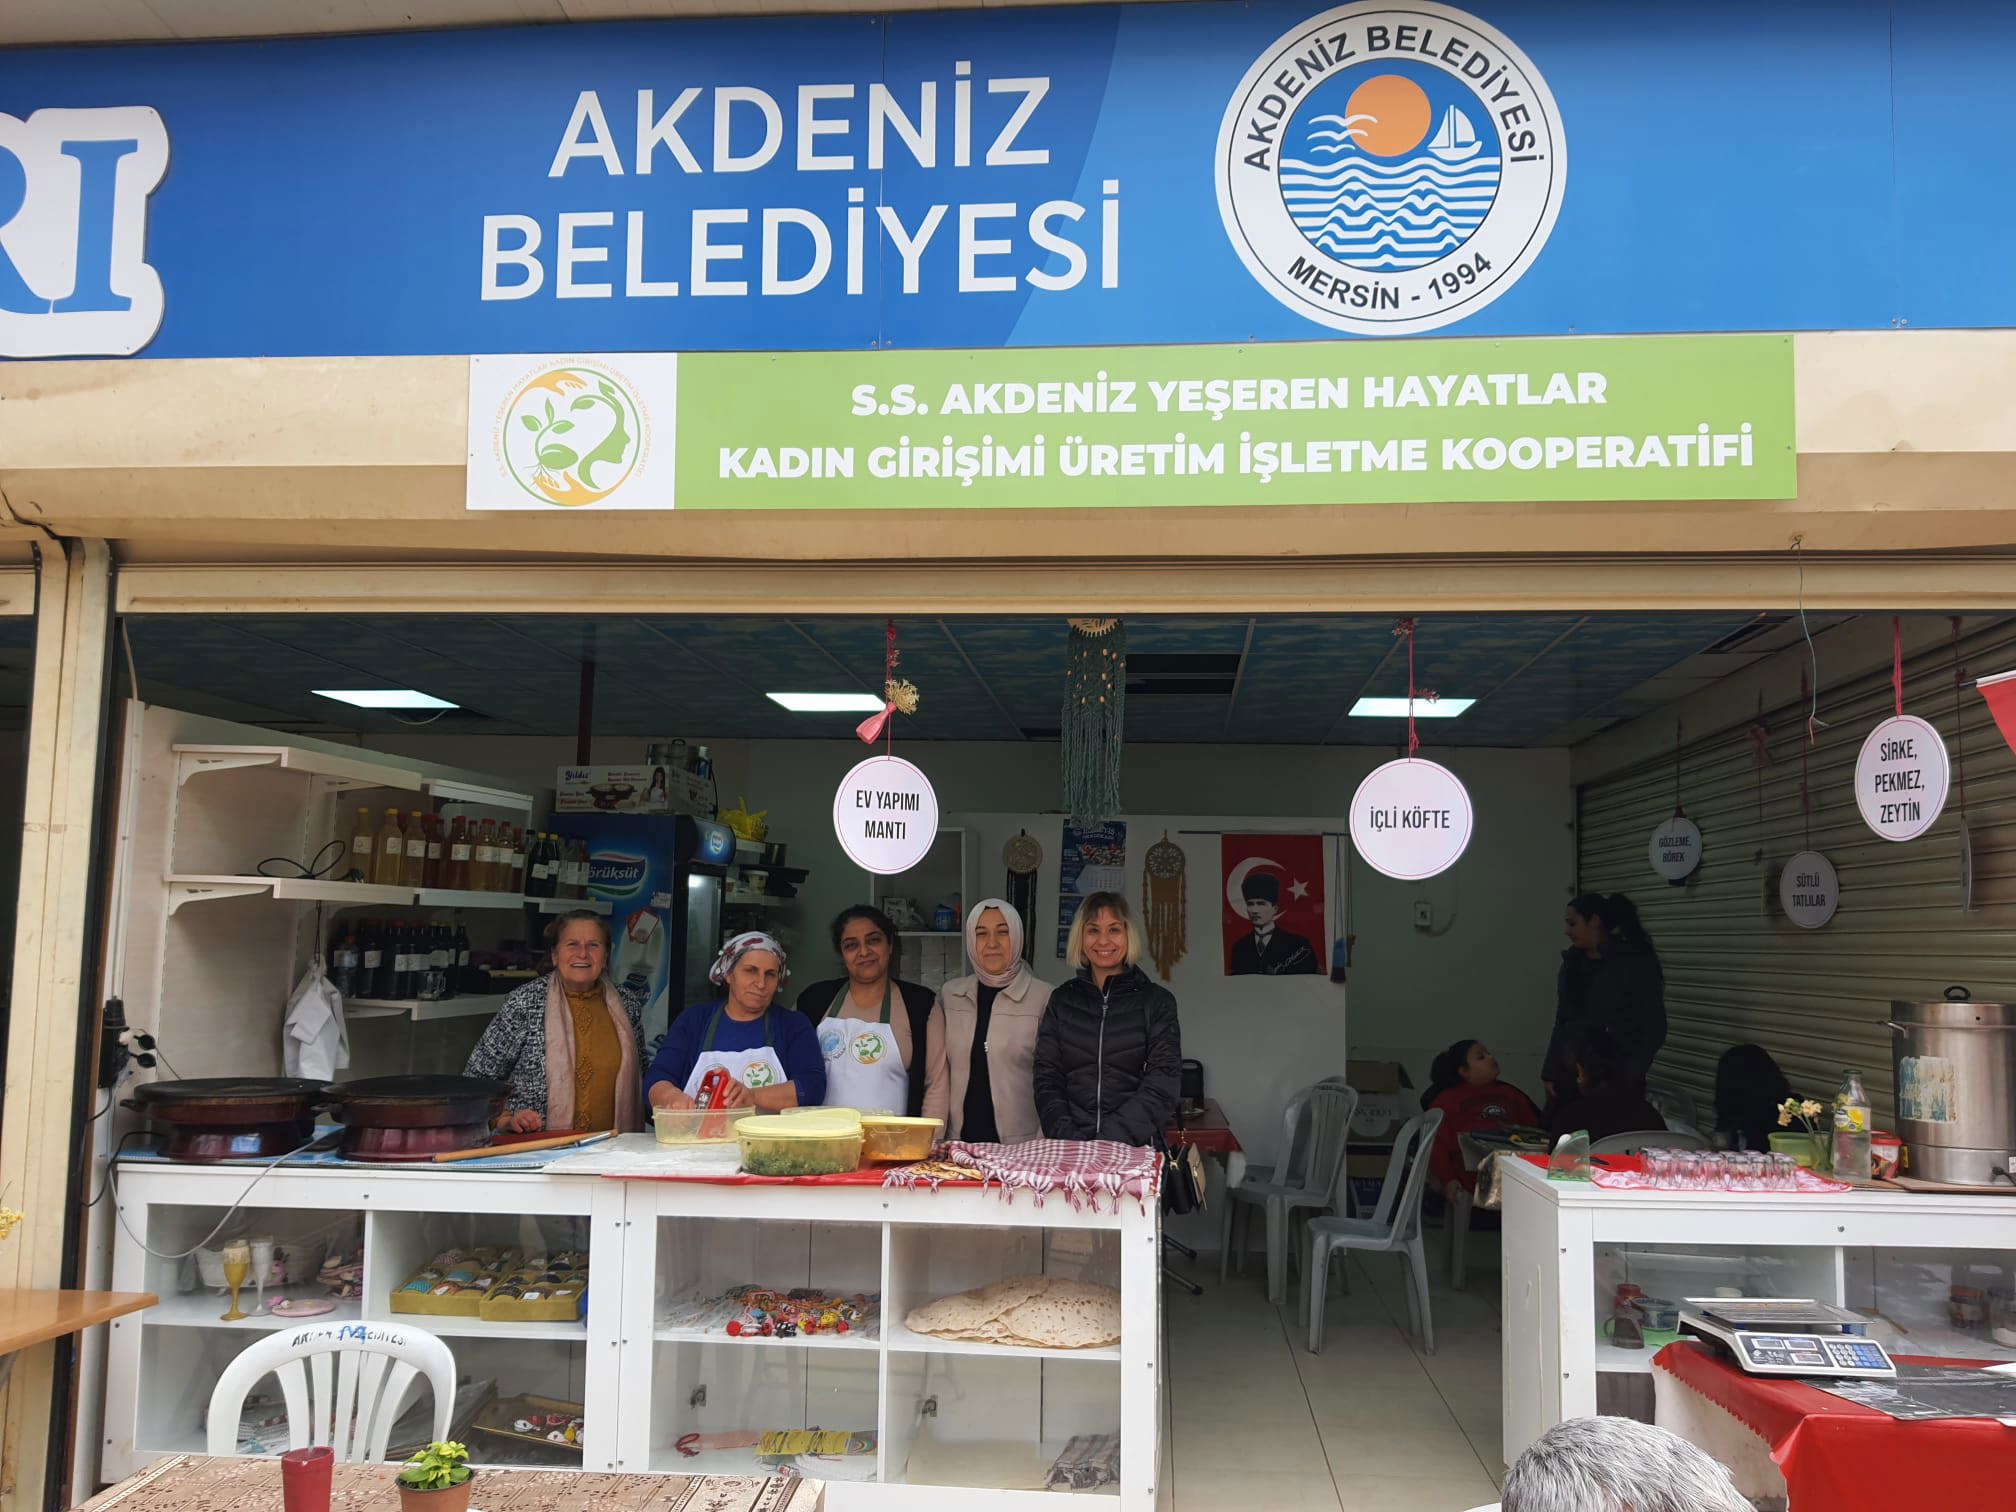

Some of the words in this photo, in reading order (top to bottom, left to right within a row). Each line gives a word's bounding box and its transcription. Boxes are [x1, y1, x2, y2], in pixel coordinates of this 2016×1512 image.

[1244, 32, 1356, 172] AKDENİZ
[1366, 25, 1545, 163] BELEDİYESİ
[547, 60, 1050, 178] AKDENİZ
[480, 179, 1119, 301] BELEDİYESİ
[1288, 256, 1400, 310] MERSİN
[1428, 252, 1492, 301] 1994
[851, 383, 929, 416] S.S.
[940, 370, 1136, 416] AKDENİZ
[1147, 378, 1348, 421] YEŞEREN
[1364, 372, 1607, 409] HAYATLAR
[719, 446, 854, 479] KADIN
[868, 434, 1046, 487] GİRİŞİMİ
[1059, 432, 1225, 477] ÜRETİM
[1239, 431, 1428, 484] İŞLETME
[1442, 422, 1753, 472] KOOPERATİFİ
[1880, 738, 1918, 762] SİRKE,
[1875, 769, 1925, 794] PEKMEZ,
[856, 789, 872, 809] EV
[876, 790, 920, 811] YAPIMI
[1880, 797, 1921, 824] ZEYTİN
[864, 820, 906, 840] MANTI
[1370, 805, 1397, 832] İÇLİ
[1402, 805, 1450, 829] KÖFTE
[588, 865, 640, 881] örüksüt
[1796, 872, 1820, 888] SÜTLÜ
[1792, 894, 1826, 907] TATLILAR
